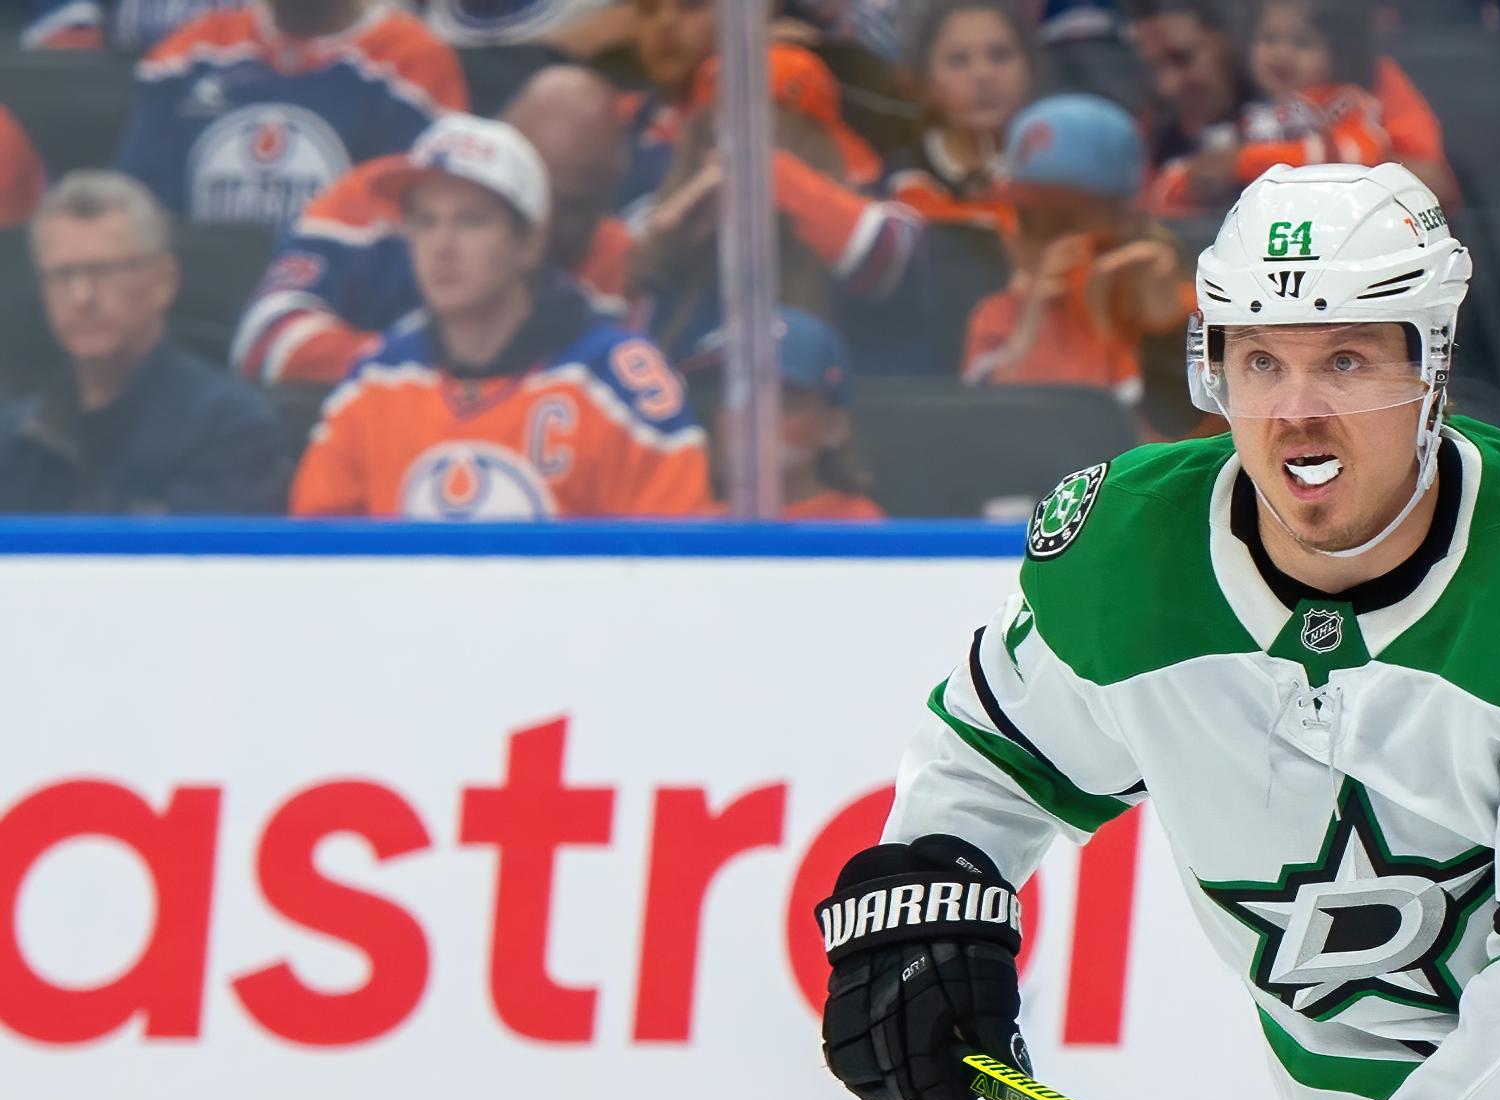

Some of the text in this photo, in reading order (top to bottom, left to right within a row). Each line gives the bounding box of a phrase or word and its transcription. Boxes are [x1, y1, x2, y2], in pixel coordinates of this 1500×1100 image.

[1268, 221, 1312, 256] 64
[524, 395, 580, 483] C
[1310, 621, 1336, 643] NHL
